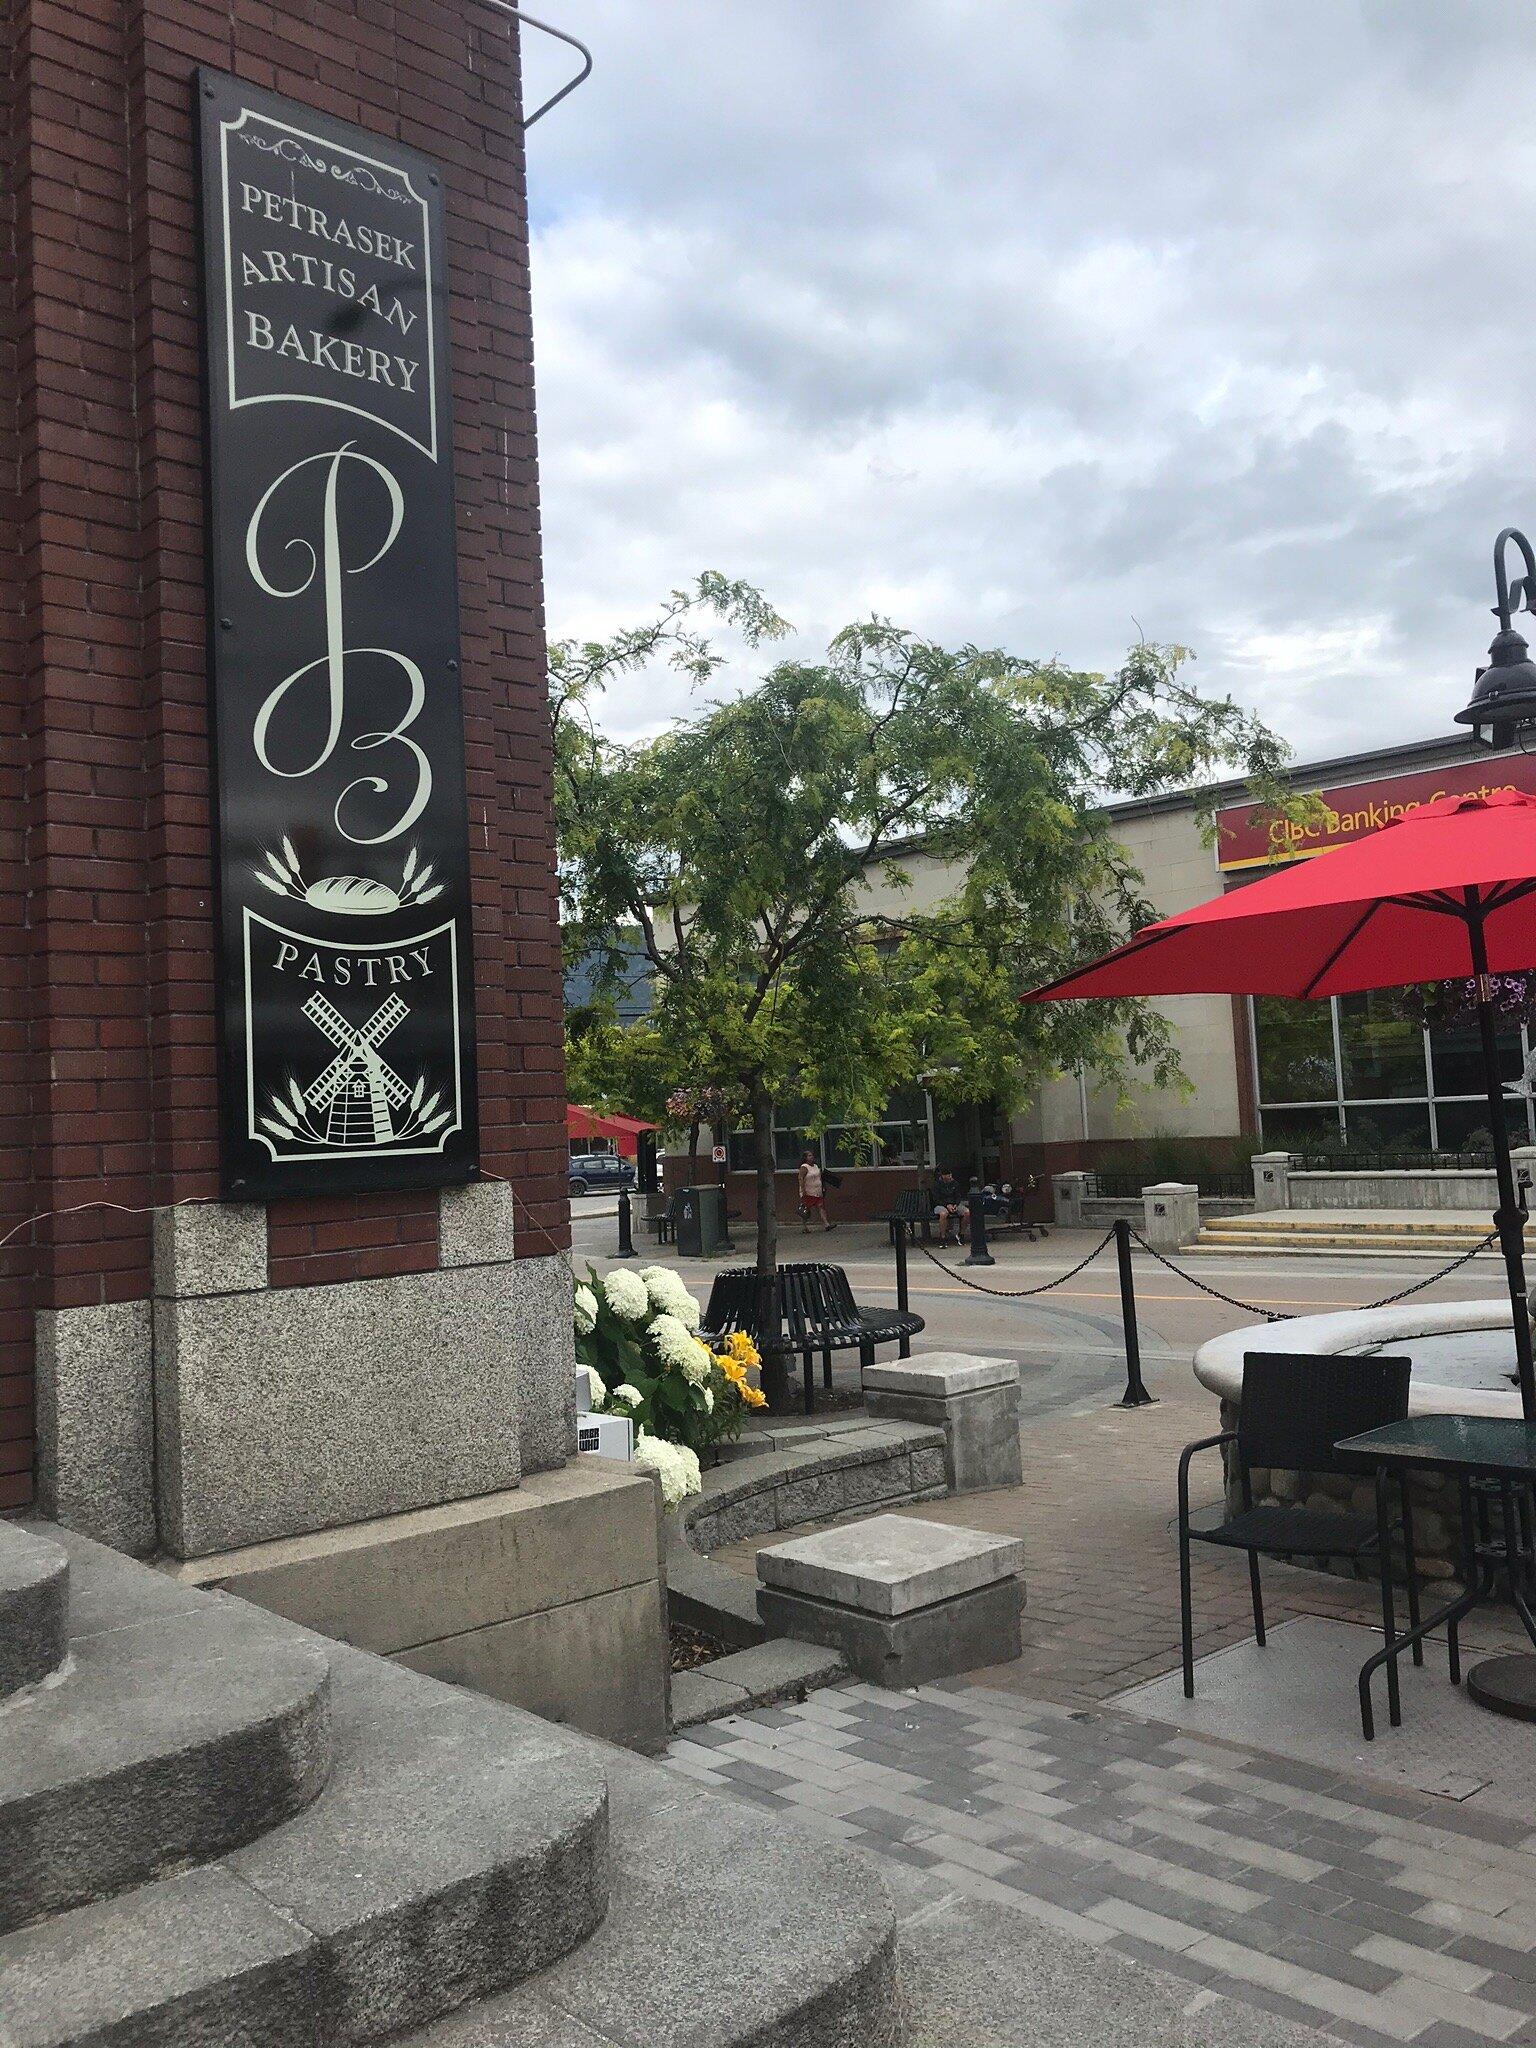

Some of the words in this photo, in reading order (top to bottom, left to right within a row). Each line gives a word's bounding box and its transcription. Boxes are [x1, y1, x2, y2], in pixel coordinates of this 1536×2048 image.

[240, 181, 416, 270] PETRASEK
[241, 250, 417, 336] ARTISAN
[244, 310, 419, 393] BAKERY
[272, 940, 434, 986] PASTRY
